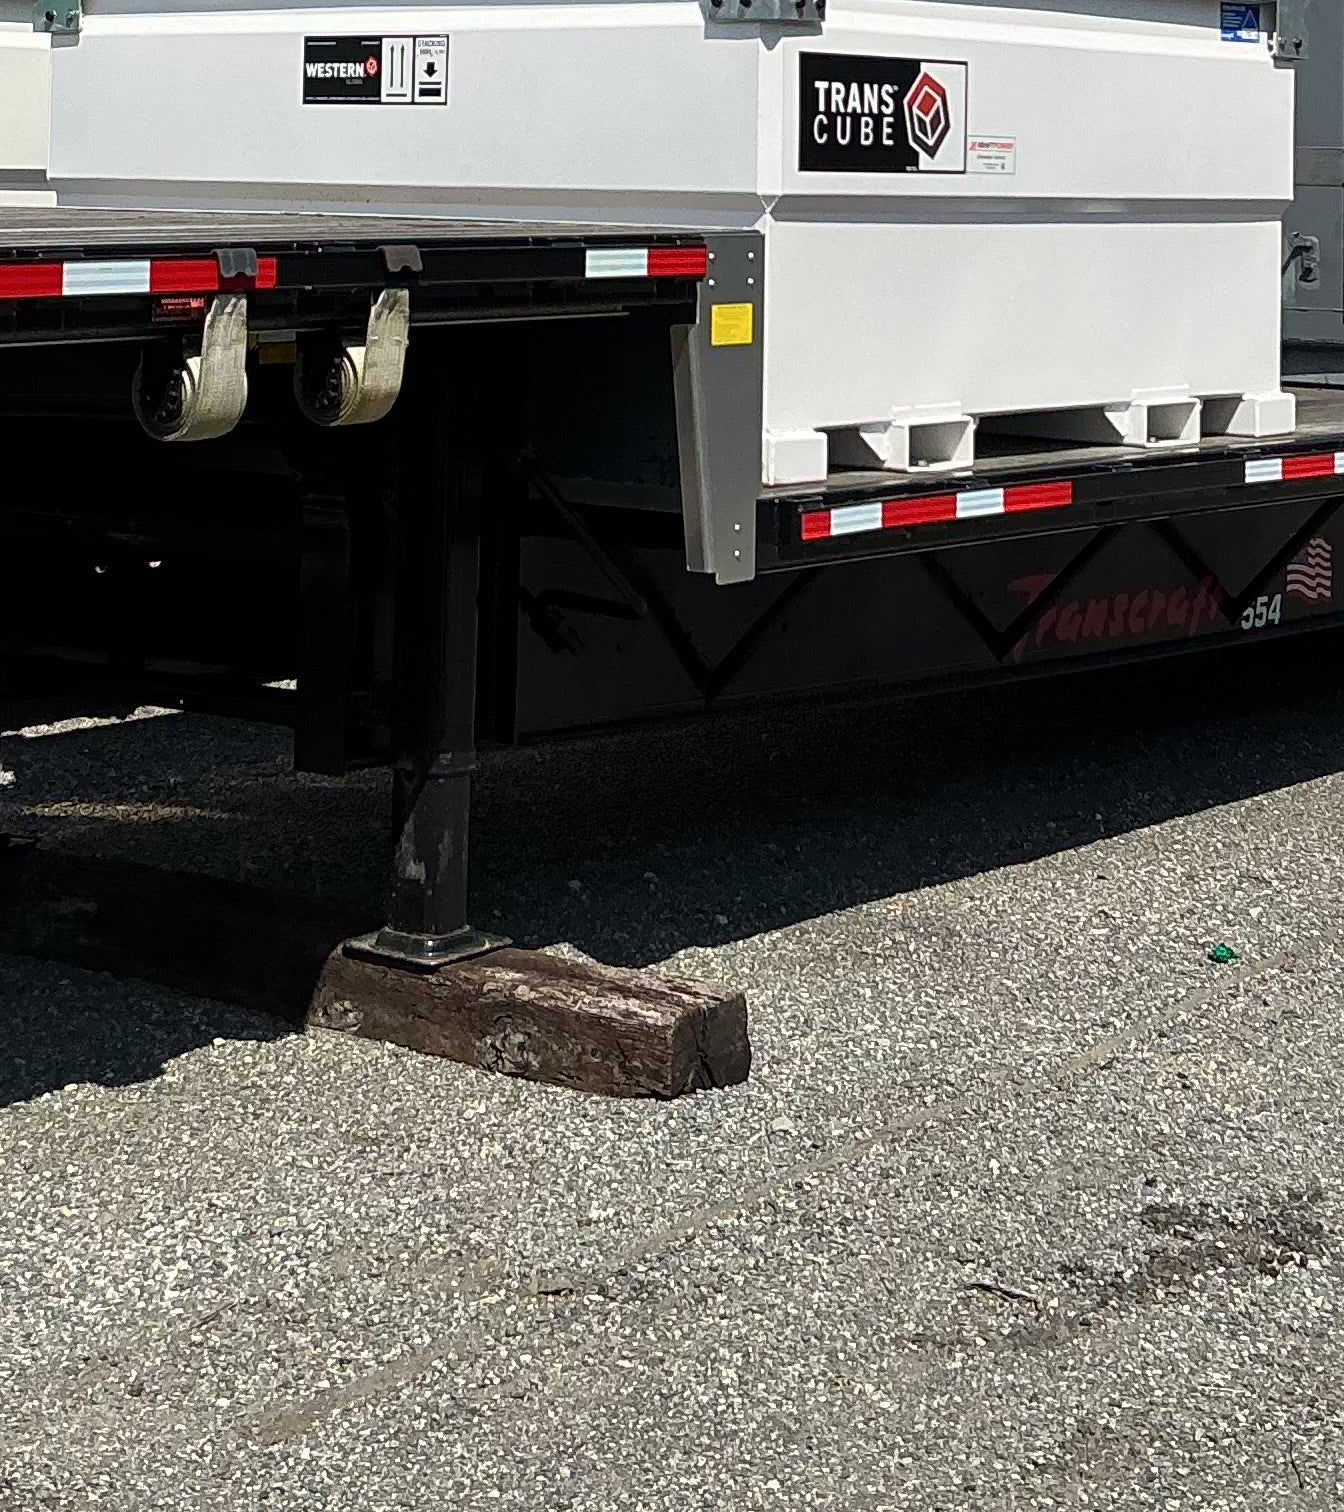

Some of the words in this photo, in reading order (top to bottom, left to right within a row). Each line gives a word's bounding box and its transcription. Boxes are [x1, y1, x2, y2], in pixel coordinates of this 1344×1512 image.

[305, 62, 365, 78] WESTERN
[813, 80, 895, 115] TRANS
[813, 114, 895, 146] CUBE
